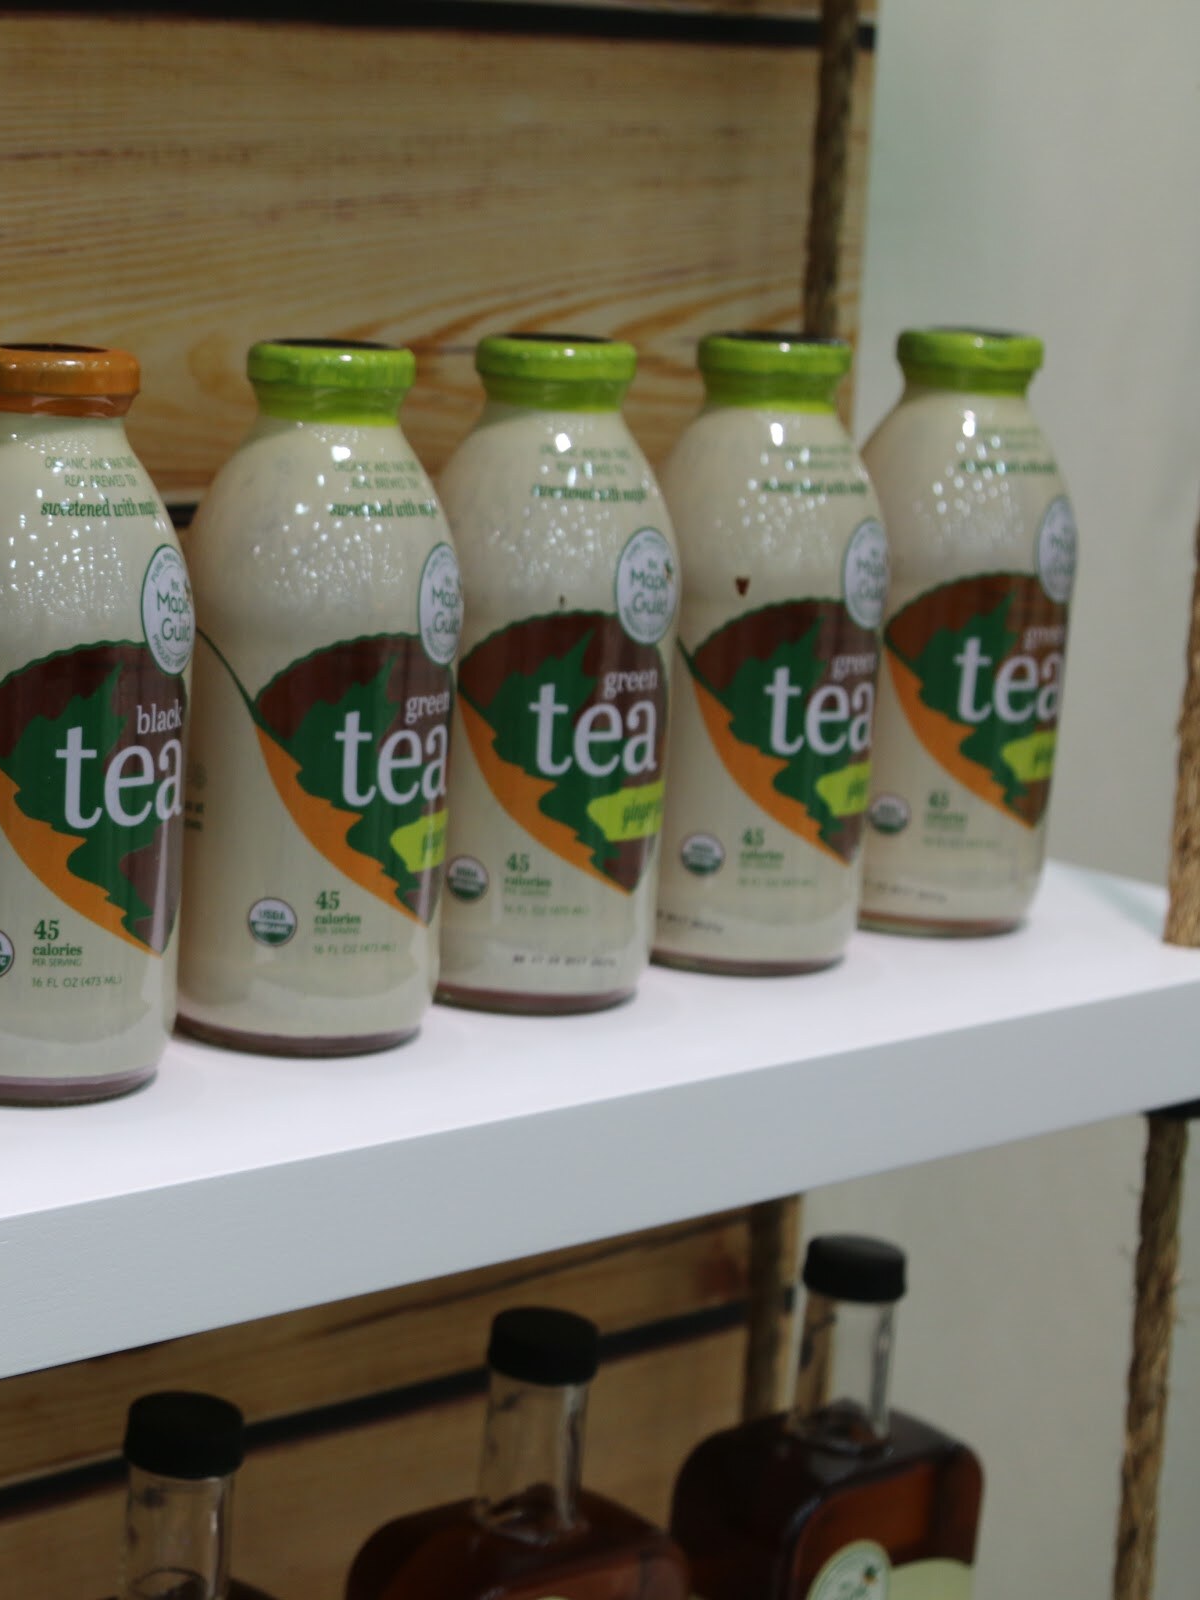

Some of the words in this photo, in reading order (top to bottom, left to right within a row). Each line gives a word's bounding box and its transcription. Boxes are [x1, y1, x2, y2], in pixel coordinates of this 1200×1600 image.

[41, 498, 112, 518] sweetened
[112, 498, 139, 517] with
[604, 668, 658, 699] green
[953, 636, 1064, 724] tea
[137, 698, 182, 735] black
[763, 666, 874, 755] tea
[528, 682, 658, 777] tea
[334, 710, 449, 807] tea
[55, 726, 182, 830] tea
[505, 853, 530, 873] 45
[315, 890, 340, 911] 45
[34, 919, 60, 941] 45
[314, 913, 361, 925] calories
[32, 943, 82, 957] calories
[47, 978, 58, 988] FL
[64, 977, 79, 988] OZ
